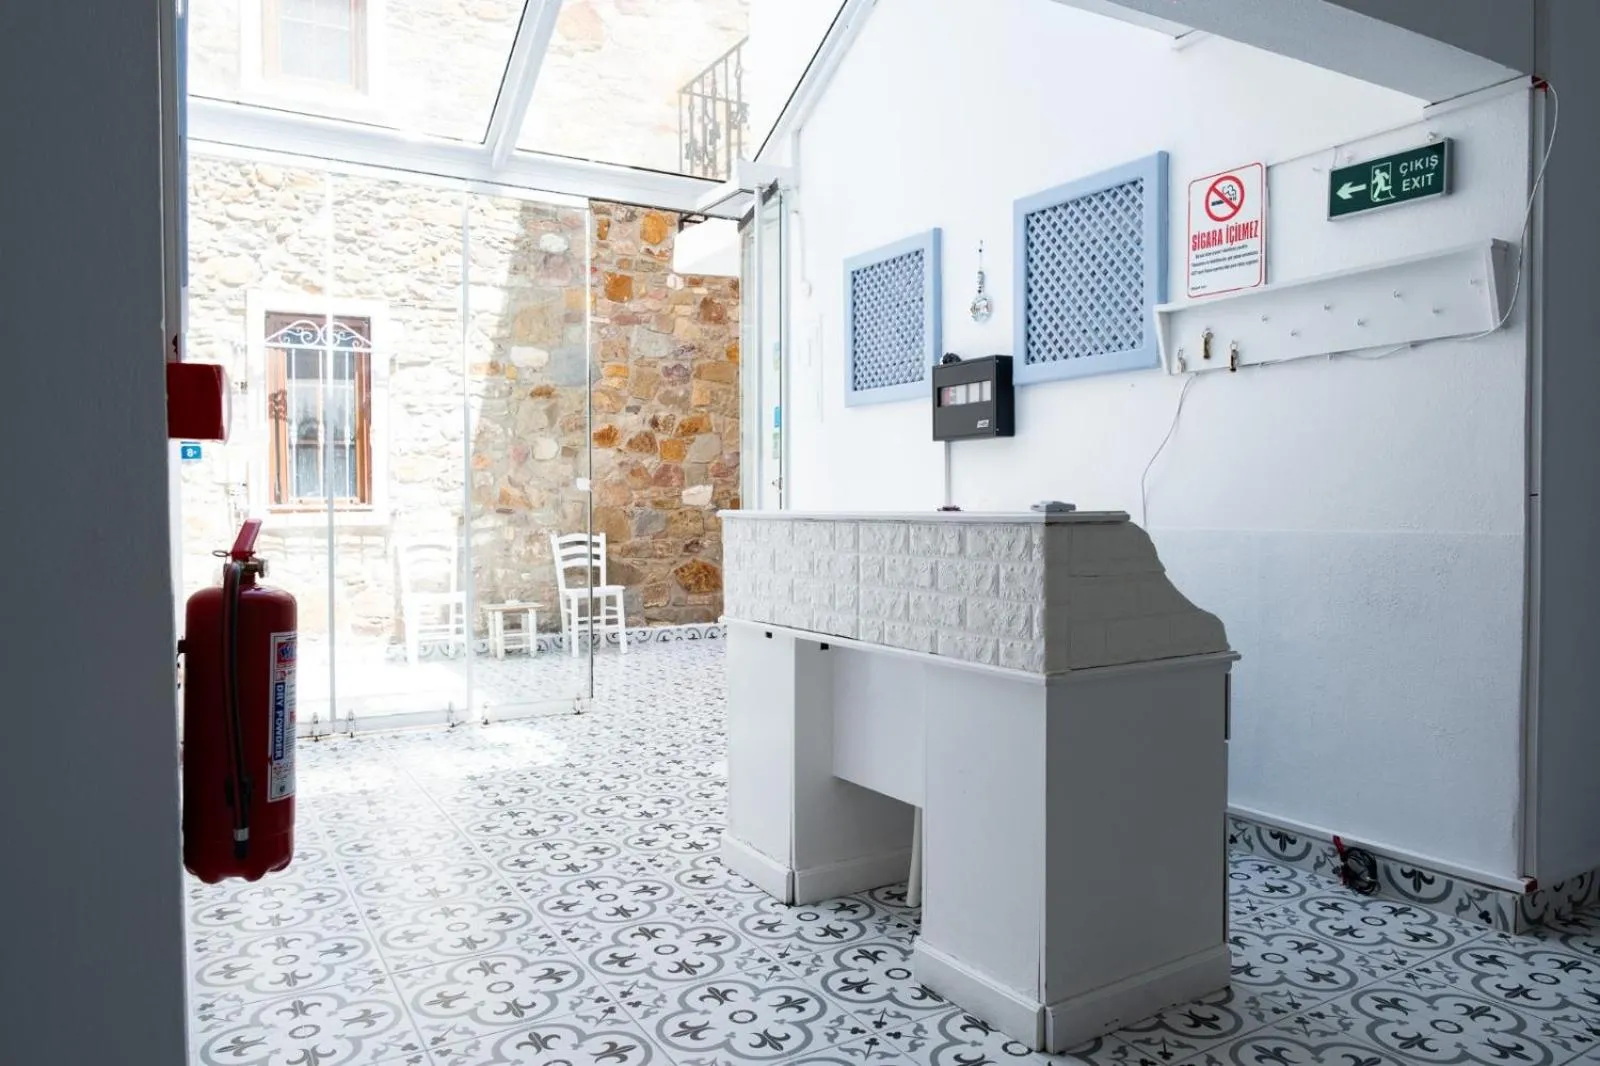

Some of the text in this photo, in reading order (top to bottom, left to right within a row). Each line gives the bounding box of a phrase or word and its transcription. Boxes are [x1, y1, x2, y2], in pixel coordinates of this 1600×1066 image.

[1399, 154, 1440, 176] ÇIKIŞ
[1402, 173, 1434, 192] EXIT
[275, 684, 284, 759] DRY POWDER
